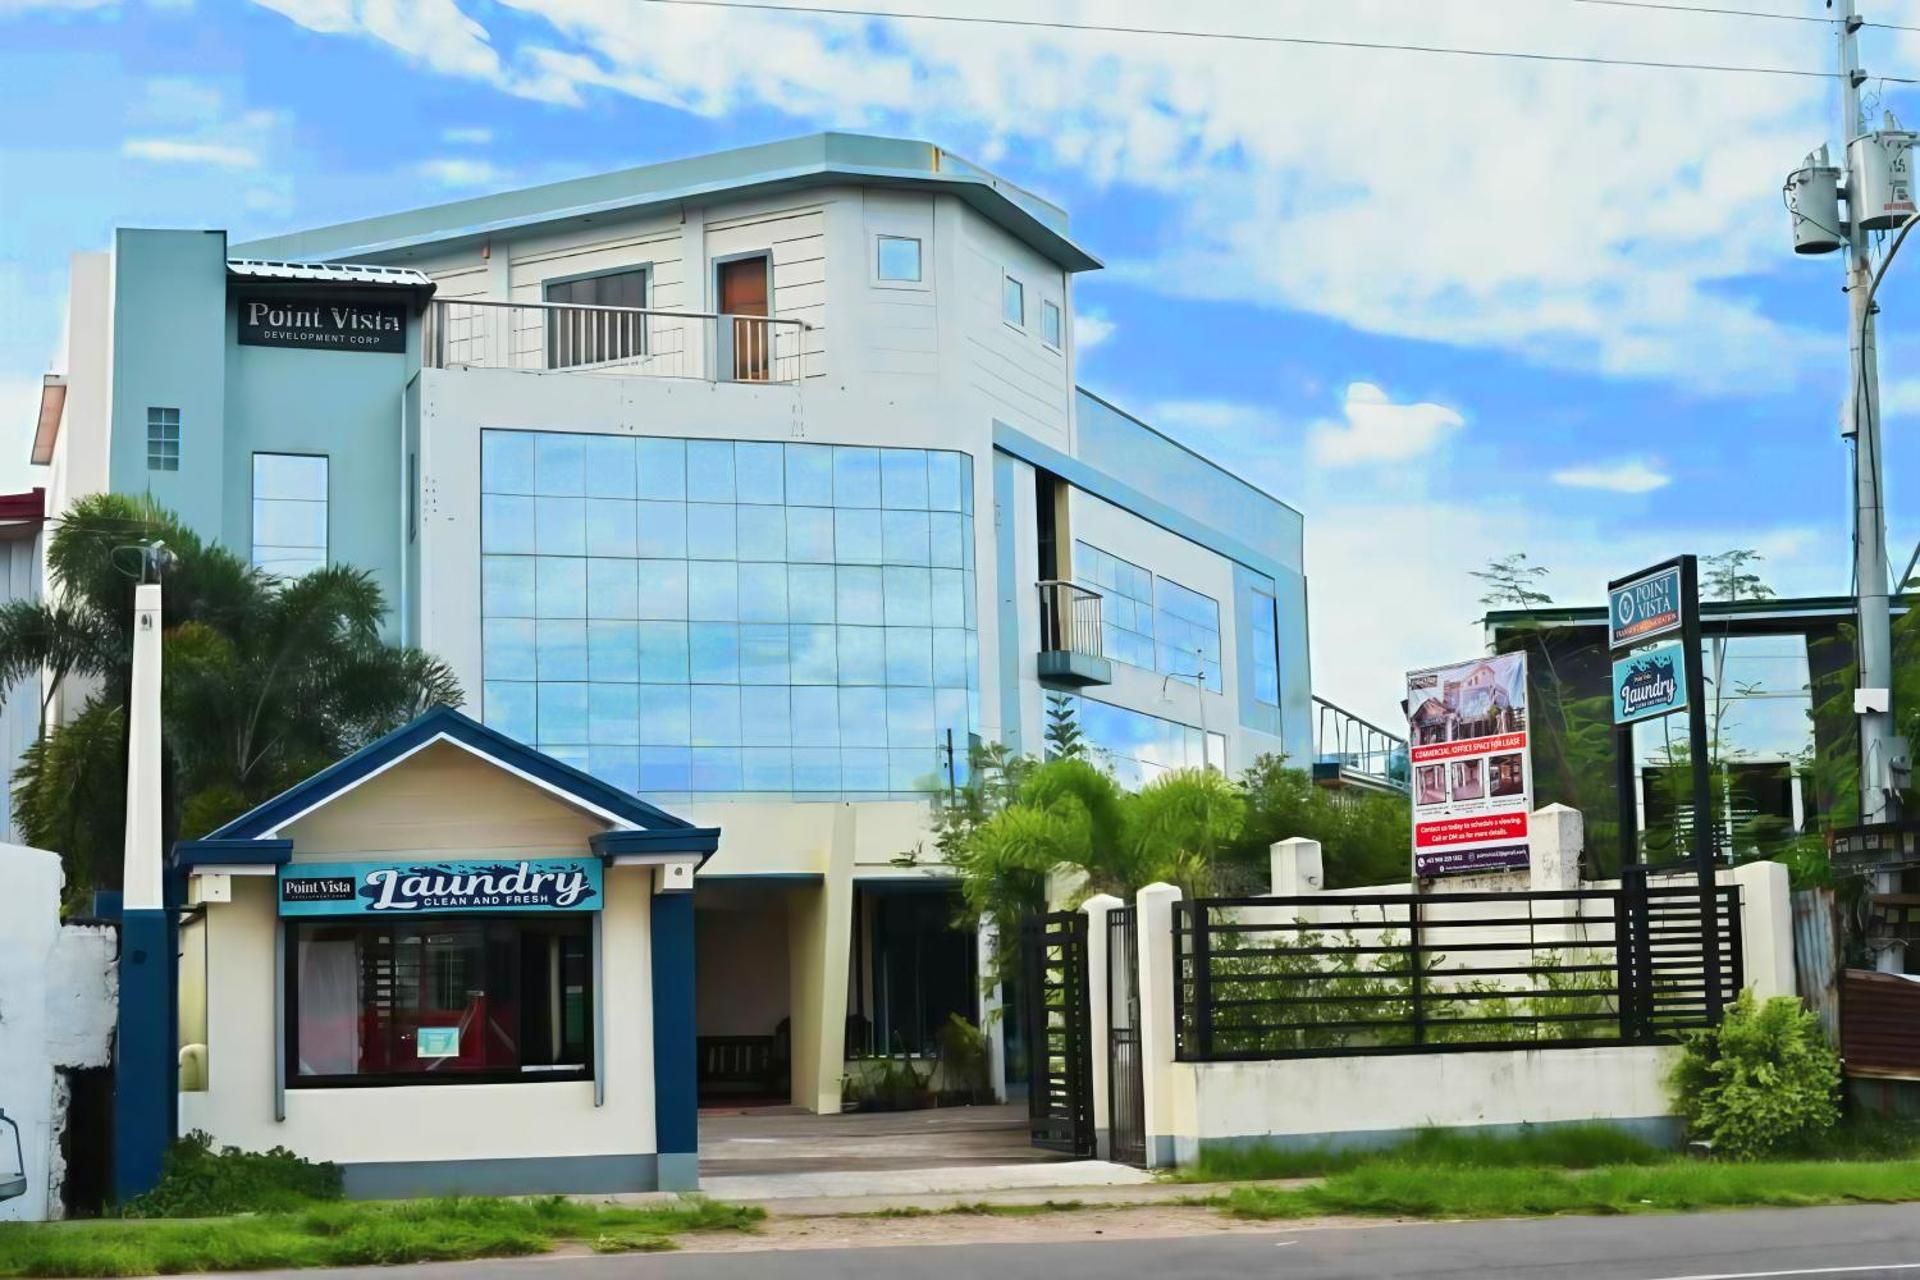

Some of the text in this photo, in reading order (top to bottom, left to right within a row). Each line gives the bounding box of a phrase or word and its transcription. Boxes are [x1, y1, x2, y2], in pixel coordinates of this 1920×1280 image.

[248, 302, 400, 331] Point Vista
[264, 330, 380, 344] DEVELOPMENT CORP
[1636, 577, 1671, 603] POINT
[1637, 596, 1671, 619] VISTA
[1621, 673, 1676, 714] Laundry
[1472, 742, 1490, 751] SPACE
[1490, 740, 1502, 749] FOR
[1502, 737, 1521, 747] LEASE
[1420, 826, 1440, 834] Contact
[1447, 823, 1463, 831] today
[1470, 820, 1494, 828] schedule
[1431, 834, 1441, 842] Call
[1448, 833, 1458, 841] DM
[1465, 831, 1474, 839] for
[285, 880, 351, 894] Point Vista
[366, 861, 589, 910] Laundry
[424, 894, 549, 906] CLEAN AND FRESH
